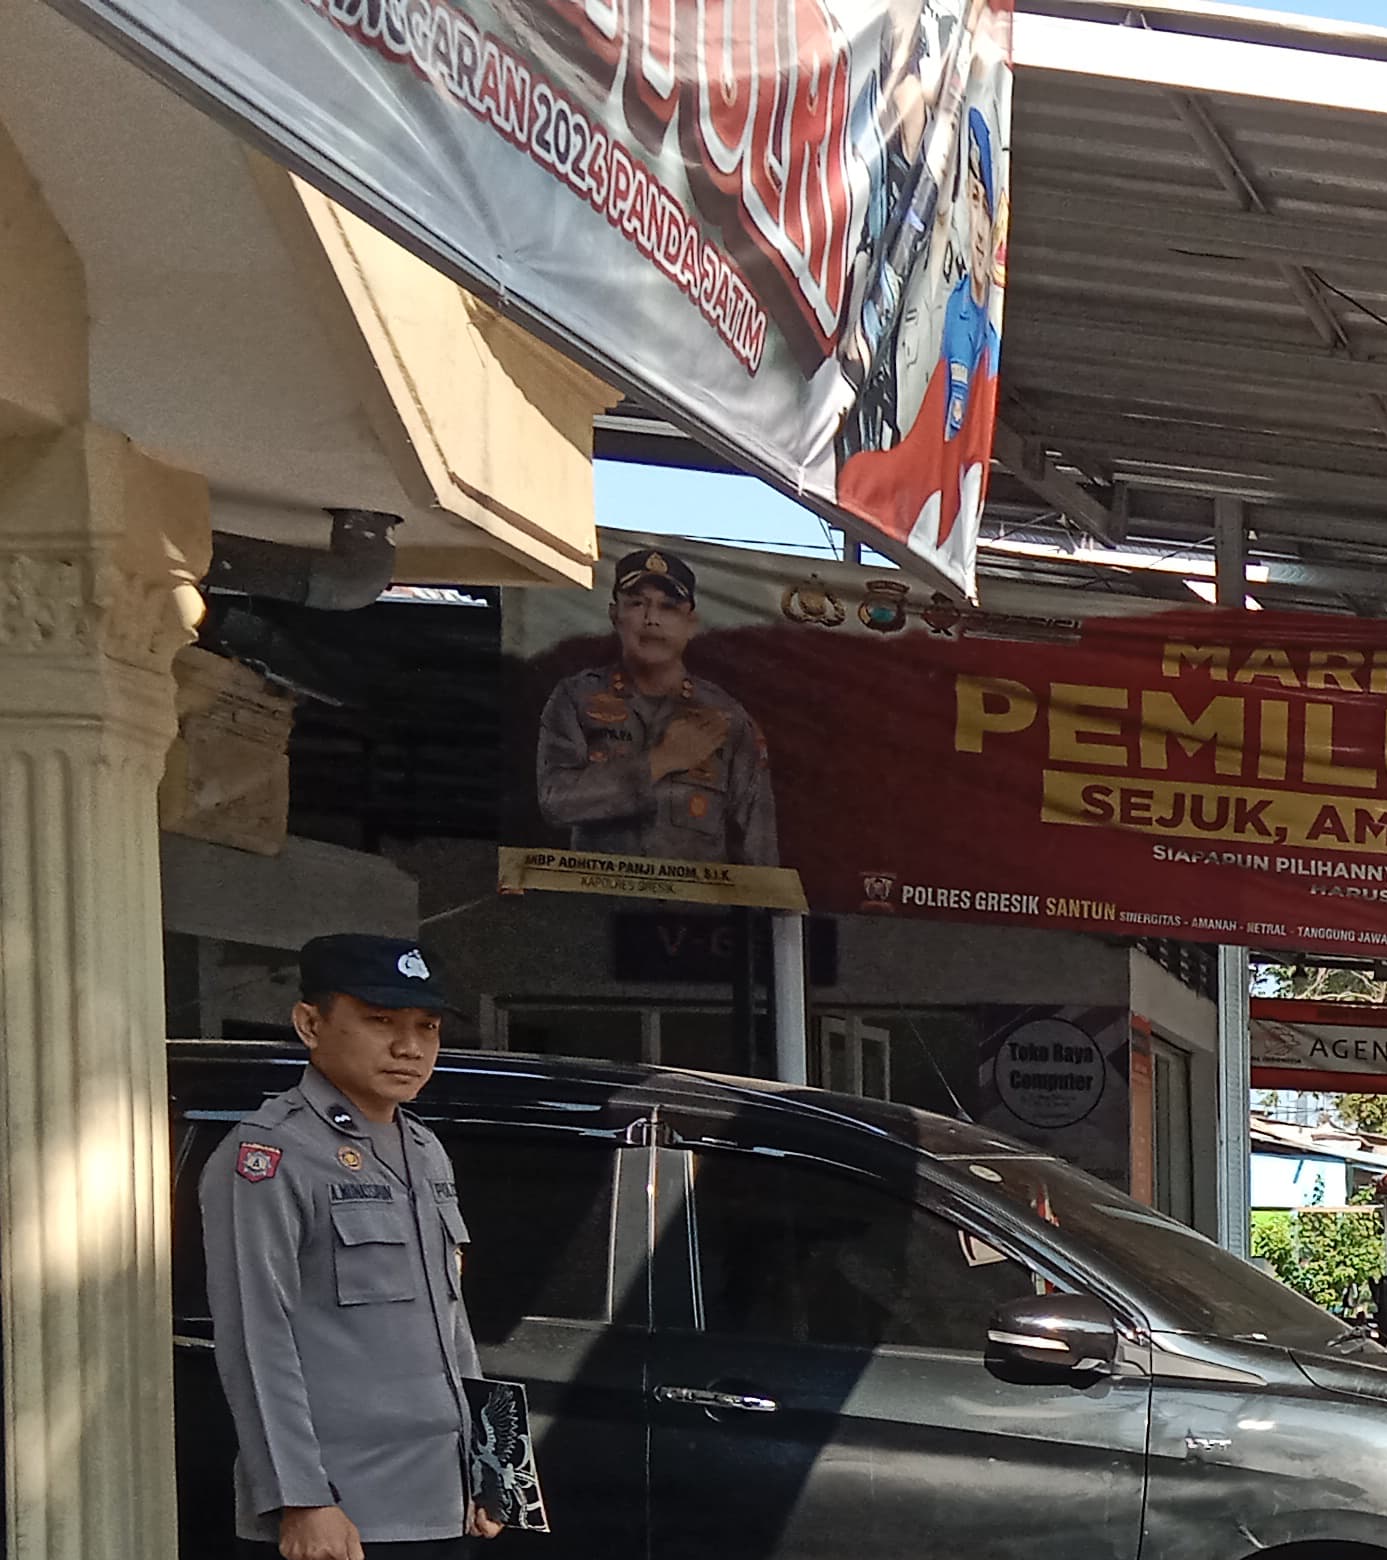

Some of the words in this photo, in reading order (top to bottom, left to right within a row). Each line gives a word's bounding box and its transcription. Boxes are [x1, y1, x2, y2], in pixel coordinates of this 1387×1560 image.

[532, 88, 607, 205] 2024
[609, 151, 701, 295] PANDA
[700, 249, 768, 370] JATIM
[1079, 783, 1289, 846] SEJUK,
[559, 856, 615, 873] ADHITYA
[617, 860, 656, 876] PANJI
[1152, 844, 1269, 873] SIAPAPUN
[901, 884, 972, 909] POLRES
[974, 890, 1040, 916] GRESIK
[1045, 896, 1116, 921] SANTUN
[1119, 910, 1182, 927] SINERGITAS
[1191, 916, 1238, 932] AMANAH
[1297, 925, 1356, 942] TANGGUNG
[1009, 1070, 1094, 1092] Computer
